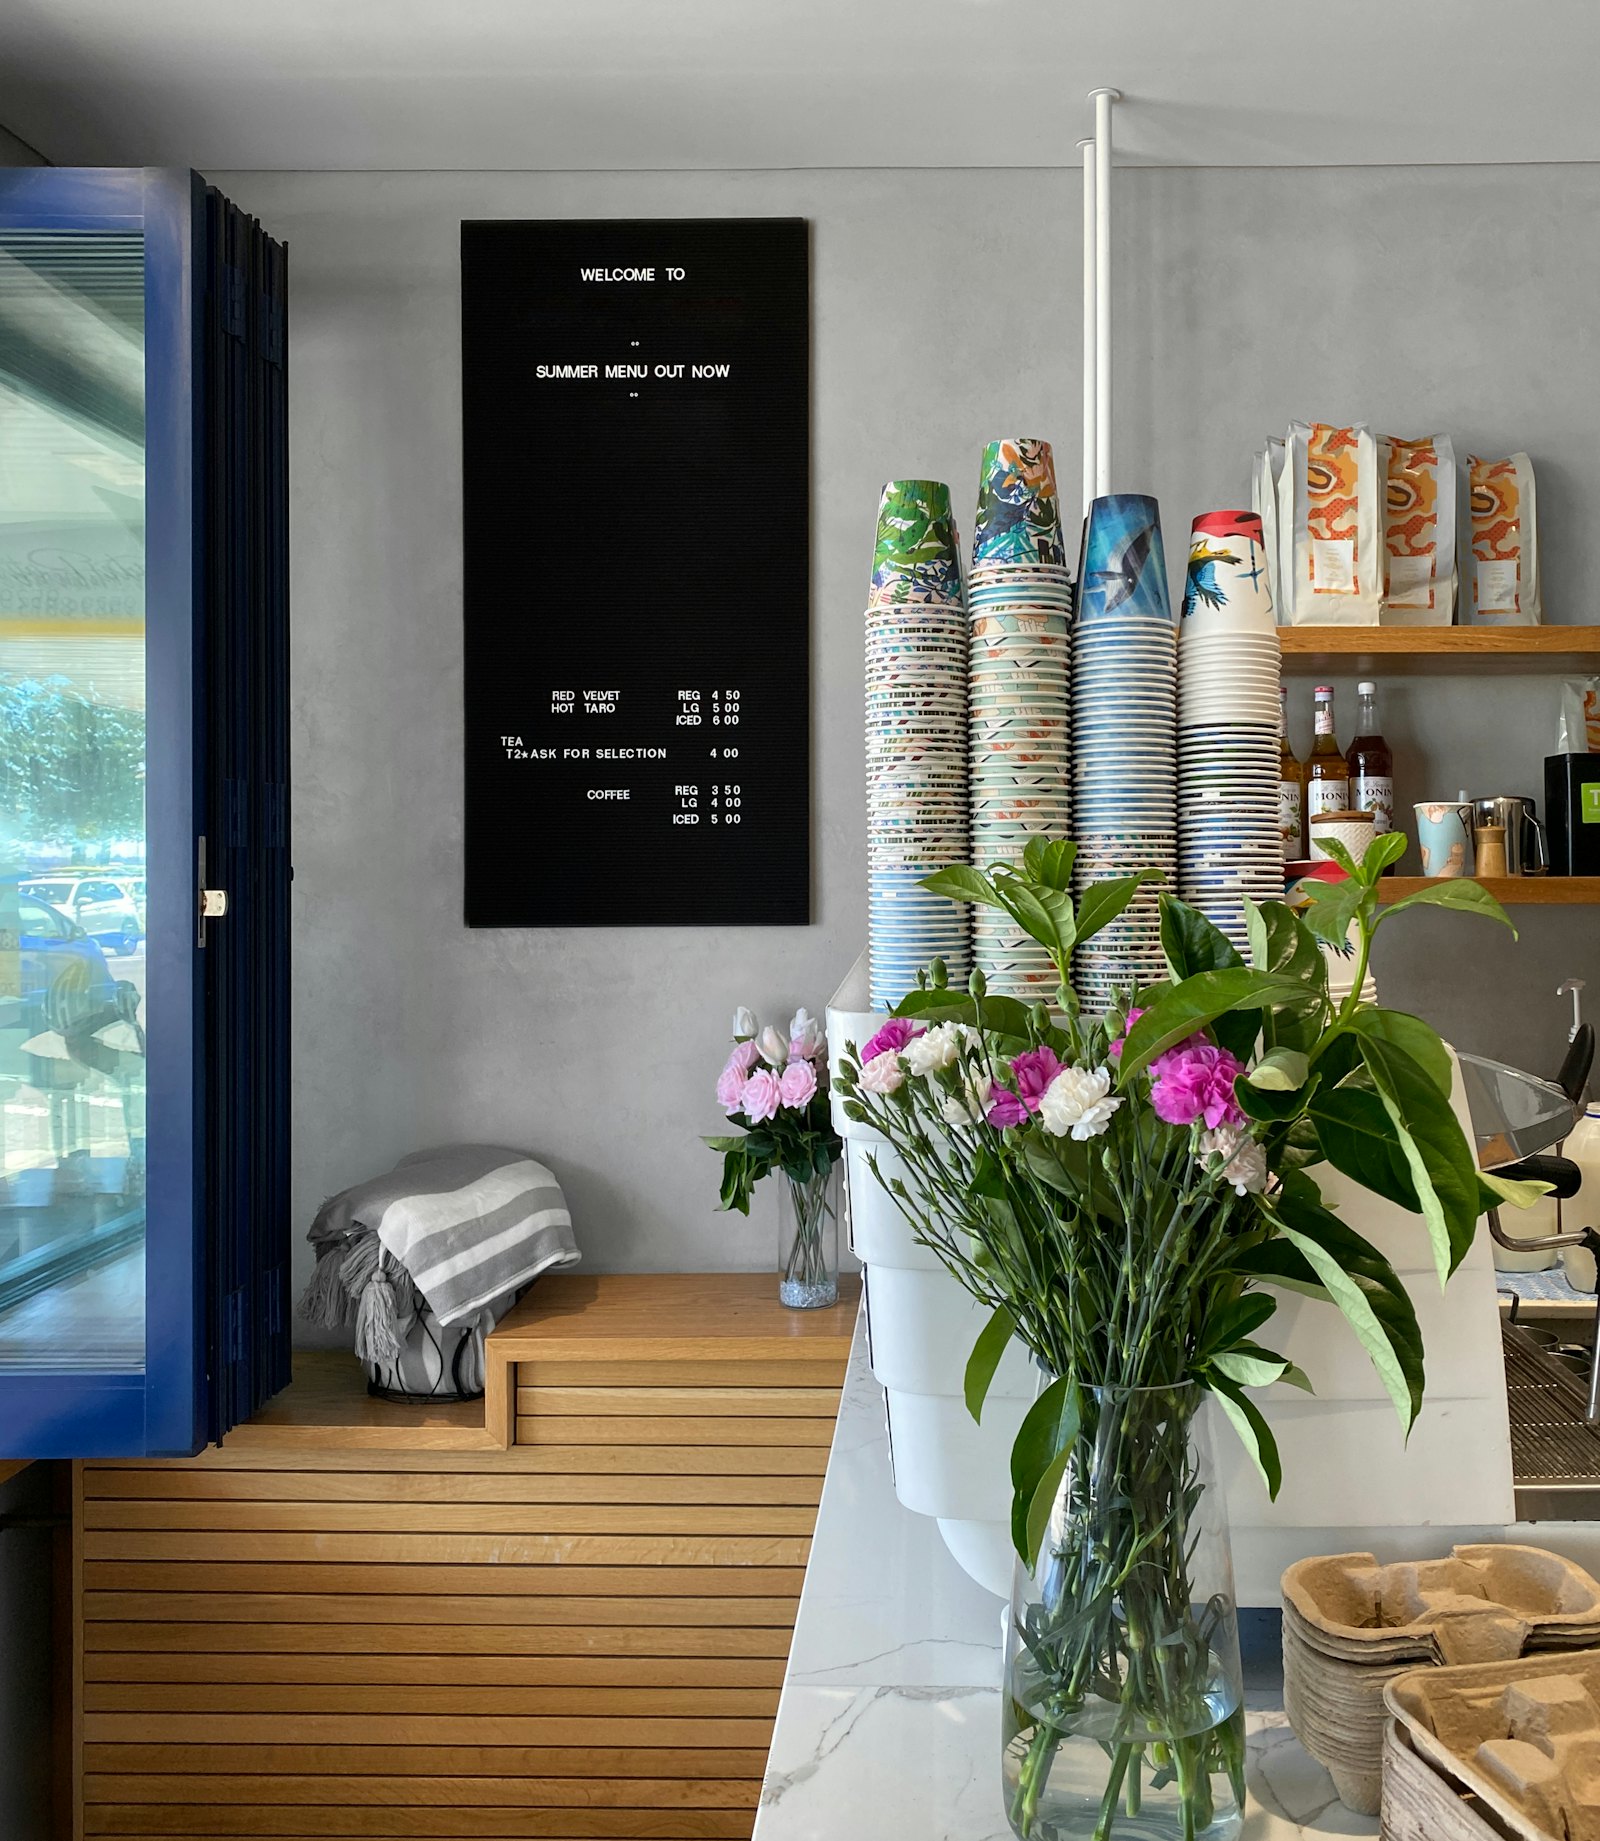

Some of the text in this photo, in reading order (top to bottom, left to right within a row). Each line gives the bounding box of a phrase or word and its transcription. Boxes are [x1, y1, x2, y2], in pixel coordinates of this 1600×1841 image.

[580, 267, 686, 282] WELCOME TO
[535, 364, 731, 379] SUMMER MENU OUT NOW
[552, 690, 621, 701] RED VELVET
[677, 690, 701, 701] REG
[725, 689, 741, 701] 50
[551, 702, 616, 714] HOT TARO
[682, 702, 700, 714] LG
[724, 702, 740, 713] 00
[675, 714, 702, 726] ICED
[723, 714, 740, 726] 00
[500, 736, 524, 747] TEA
[563, 748, 590, 759] FOR
[595, 747, 667, 759] SELECTION
[723, 747, 739, 759] 00
[586, 789, 631, 801] COFFEE
[674, 785, 699, 796] REG
[724, 784, 741, 796] 50
[681, 797, 698, 808] LG
[725, 797, 742, 808] 00
[1279, 792, 1299, 801] NIN
[1315, 792, 1348, 801] MONI
[672, 813, 700, 825] ICED
[724, 813, 741, 825] 00
